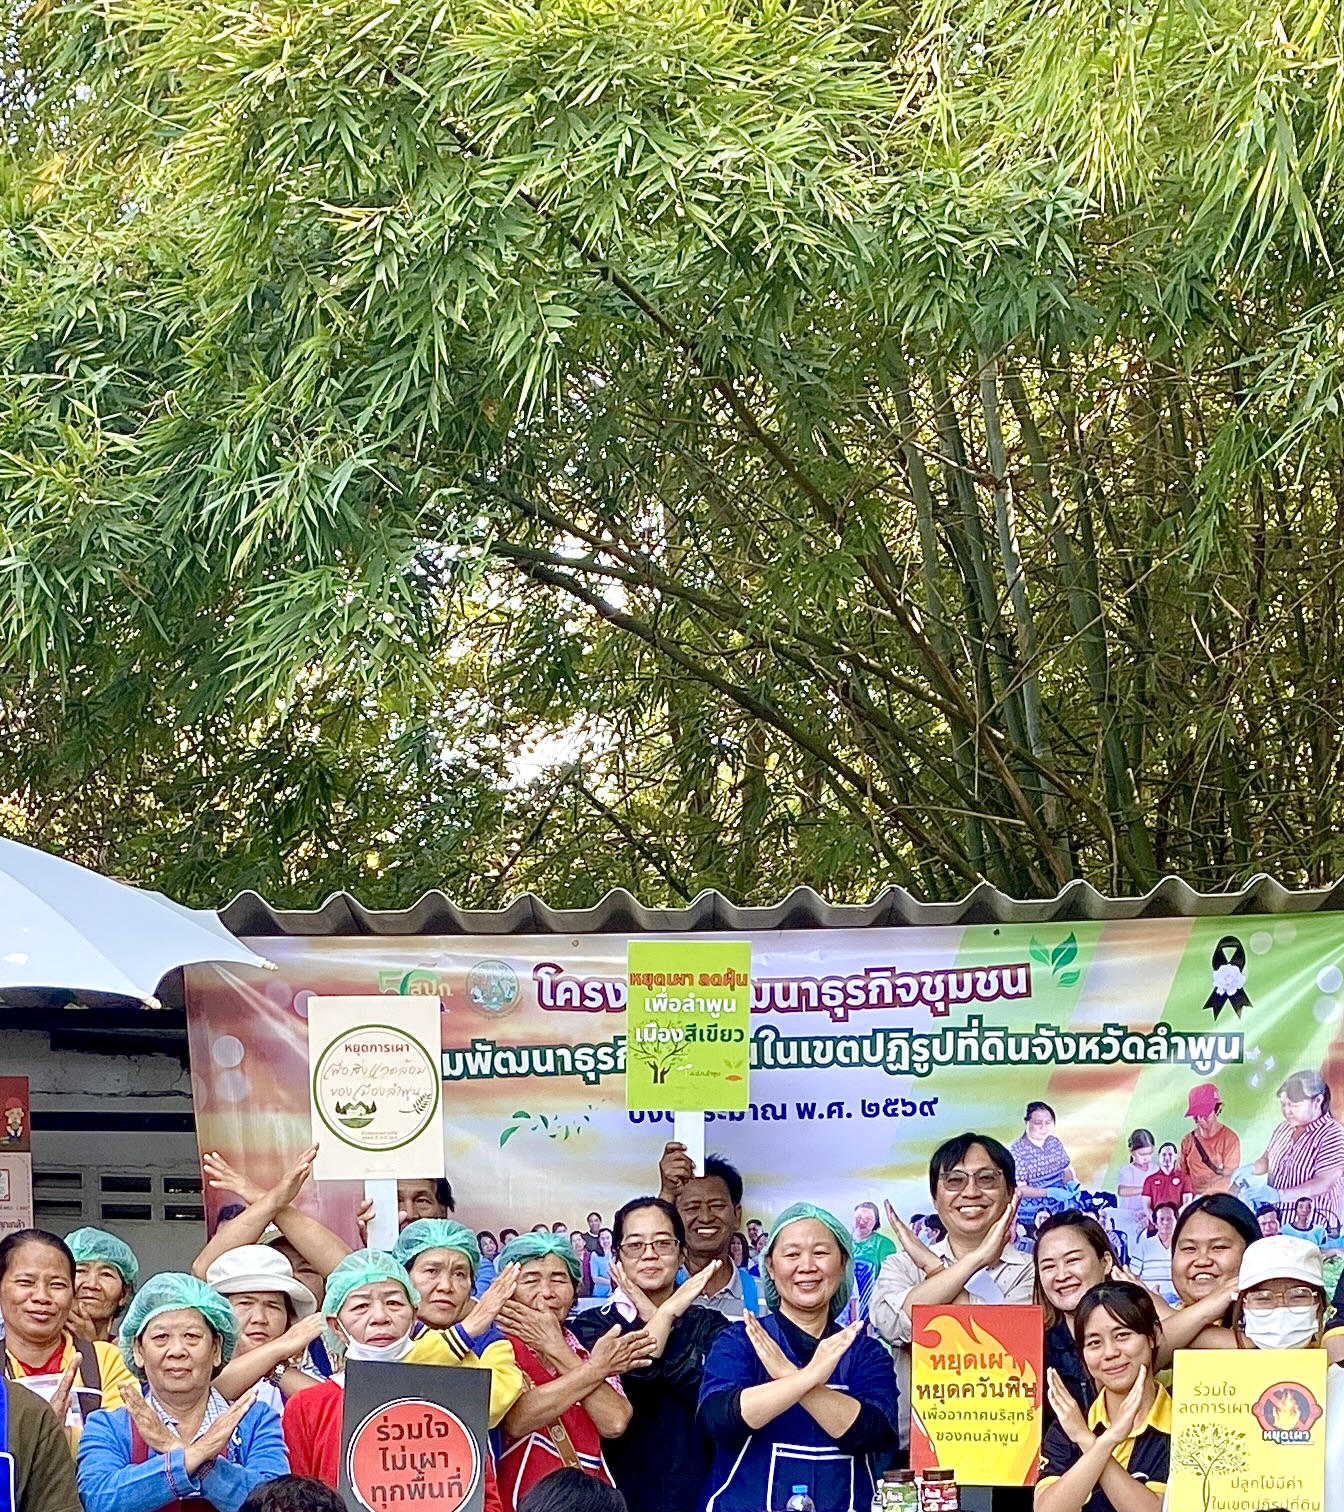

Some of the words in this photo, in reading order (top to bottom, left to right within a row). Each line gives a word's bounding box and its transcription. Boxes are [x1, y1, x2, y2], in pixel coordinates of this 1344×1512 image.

[629, 972, 695, 991] หยุดเผา
[644, 986, 737, 1018] เพื่อลำพูน
[635, 1021, 745, 1044] เมืองสีเขียว
[344, 1042, 410, 1056] หยุดการเผา
[796, 1100, 853, 1120] พ.ศ.
[860, 1096, 939, 1119] ๒๕๖๙
[929, 1352, 1017, 1376] หยุดเผา
[916, 1376, 1038, 1404] หยุดควันพิษ
[1193, 1381, 1237, 1397] ร่วมใจ
[1179, 1403, 1250, 1414] ลดการเผา
[376, 1414, 449, 1441] ร่วมใจ
[936, 1429, 1019, 1446] ของคนลำพูน
[1263, 1430, 1310, 1444] หยุดเผา
[378, 1447, 449, 1472] ไม่เผา
[370, 1467, 464, 1509] ทุกพื้นที่
[1231, 1475, 1303, 1492] ปลูกไม้มีค่า
